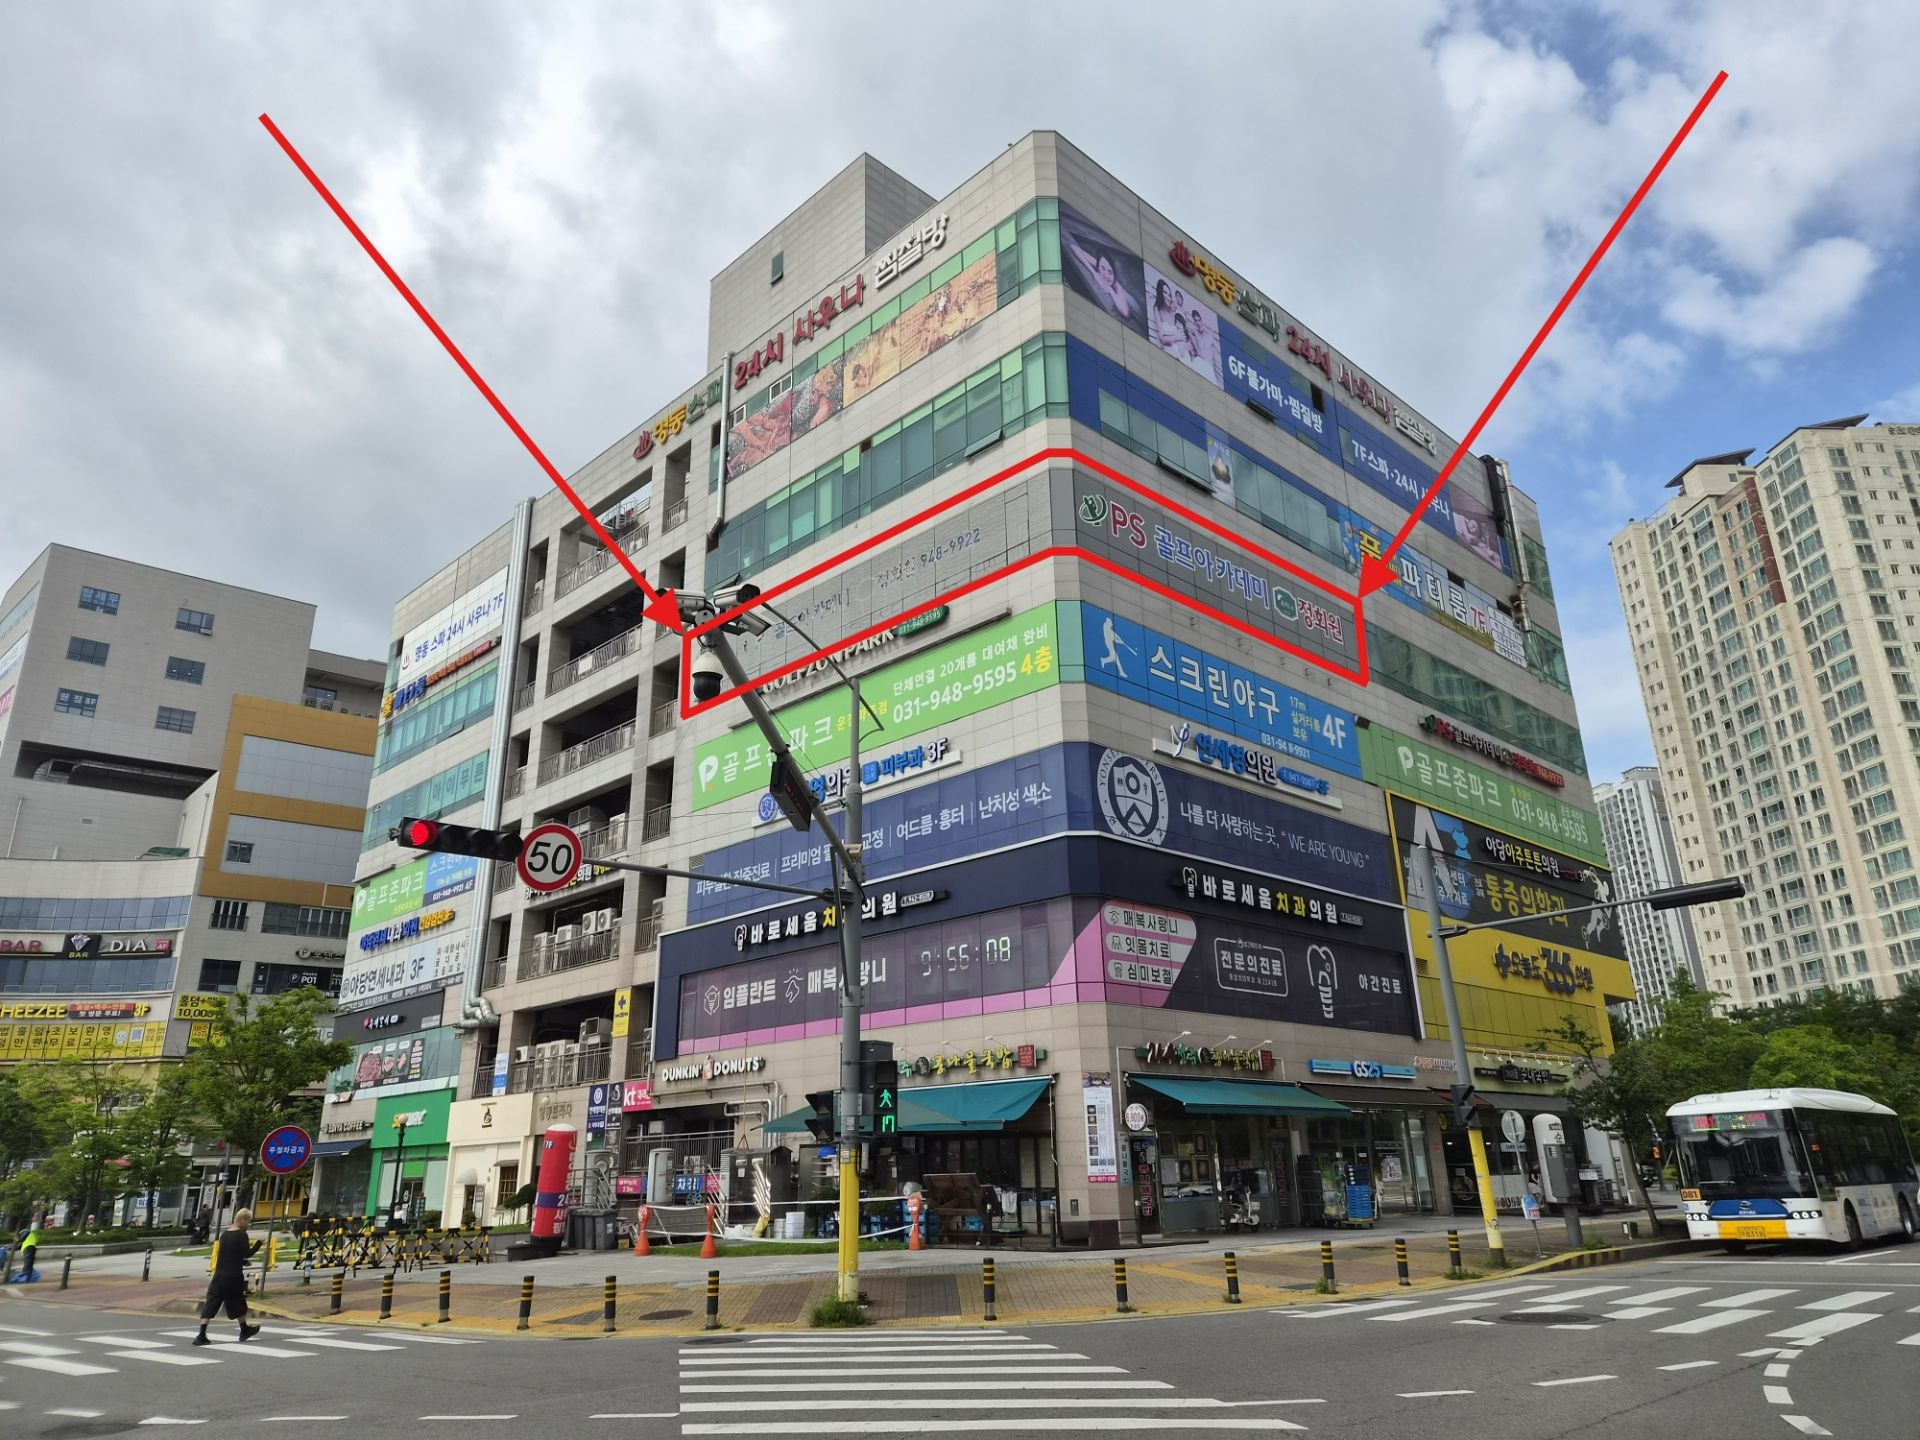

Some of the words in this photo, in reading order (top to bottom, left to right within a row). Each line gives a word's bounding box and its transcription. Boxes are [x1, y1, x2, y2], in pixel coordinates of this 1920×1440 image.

[652, 403, 688, 445] 명동
[734, 332, 784, 391] 24시
[792, 273, 867, 345] 사우나
[875, 213, 950, 292] 찜질방
[1193, 255, 1238, 306] 명동
[1236, 289, 1280, 343] 스파
[1285, 325, 1333, 381] 24시
[1337, 363, 1391, 425] 사우나
[1352, 439, 1367, 462] 7F
[1110, 500, 1147, 549] PS
[1153, 524, 1270, 610] 골프아카데미
[1298, 597, 1345, 646] 정화원
[1400, 556, 1467, 625] 파티룸
[466, 599, 492, 627] 사우나
[893, 667, 936, 697] 단체연결
[939, 651, 977, 679] 20개룸
[1023, 623, 1048, 646] 완비
[892, 660, 1017, 724] 031-948-9595
[1019, 645, 1054, 677] 4층
[1149, 645, 1280, 725] 스크린야구
[721, 712, 832, 784] 골프파크
[1322, 713, 1346, 750] 4F
[881, 745, 923, 778] 피부과
[927, 736, 949, 763] 3F
[1194, 732, 1278, 787] 연세영의원
[1416, 751, 1503, 807] 골프존파크
[780, 844, 822, 873] 프리미엄
[896, 804, 965, 841] 여드름·흉터
[978, 788, 1020, 820] 난치성
[1022, 781, 1052, 805] 색소
[1181, 801, 1205, 827] 나를
[1206, 809, 1219, 831] 더
[1220, 813, 1264, 842] 사랑하는
[1288, 832, 1306, 853] WE
[1307, 839, 1328, 859] ARE
[1511, 797, 1589, 845] 031-948-9595
[527, 841, 573, 875] 50
[366, 871, 425, 912] 골프존파크
[1202, 874, 1339, 925] 바로세움치과의원
[751, 892, 898, 944] 바로세움치의원
[1123, 910, 1178, 935] 매복사랑니
[0, 939, 43, 953] BAR
[68, 951, 89, 959] BAR
[109, 939, 148, 952] DIA
[1125, 936, 1171, 959] 잇몸치료
[1220, 950, 1284, 977] 전문의진료
[350, 961, 405, 996] 야당연세내과
[409, 956, 425, 980] 3F
[723, 977, 777, 1010] 임플란트
[807, 957, 887, 994] 매복랑니
[1127, 963, 1173, 985] 심미보철
[1358, 973, 1403, 995] 야간진료
[134, 1003, 149, 1017] 3F
[662, 1066, 702, 1082] DUNKIN'
[713, 1056, 761, 1075] DONUTS
[1353, 1060, 1383, 1079] GS25
[623, 1086, 637, 1107] kt
[1682, 1190, 1699, 1199] 081
